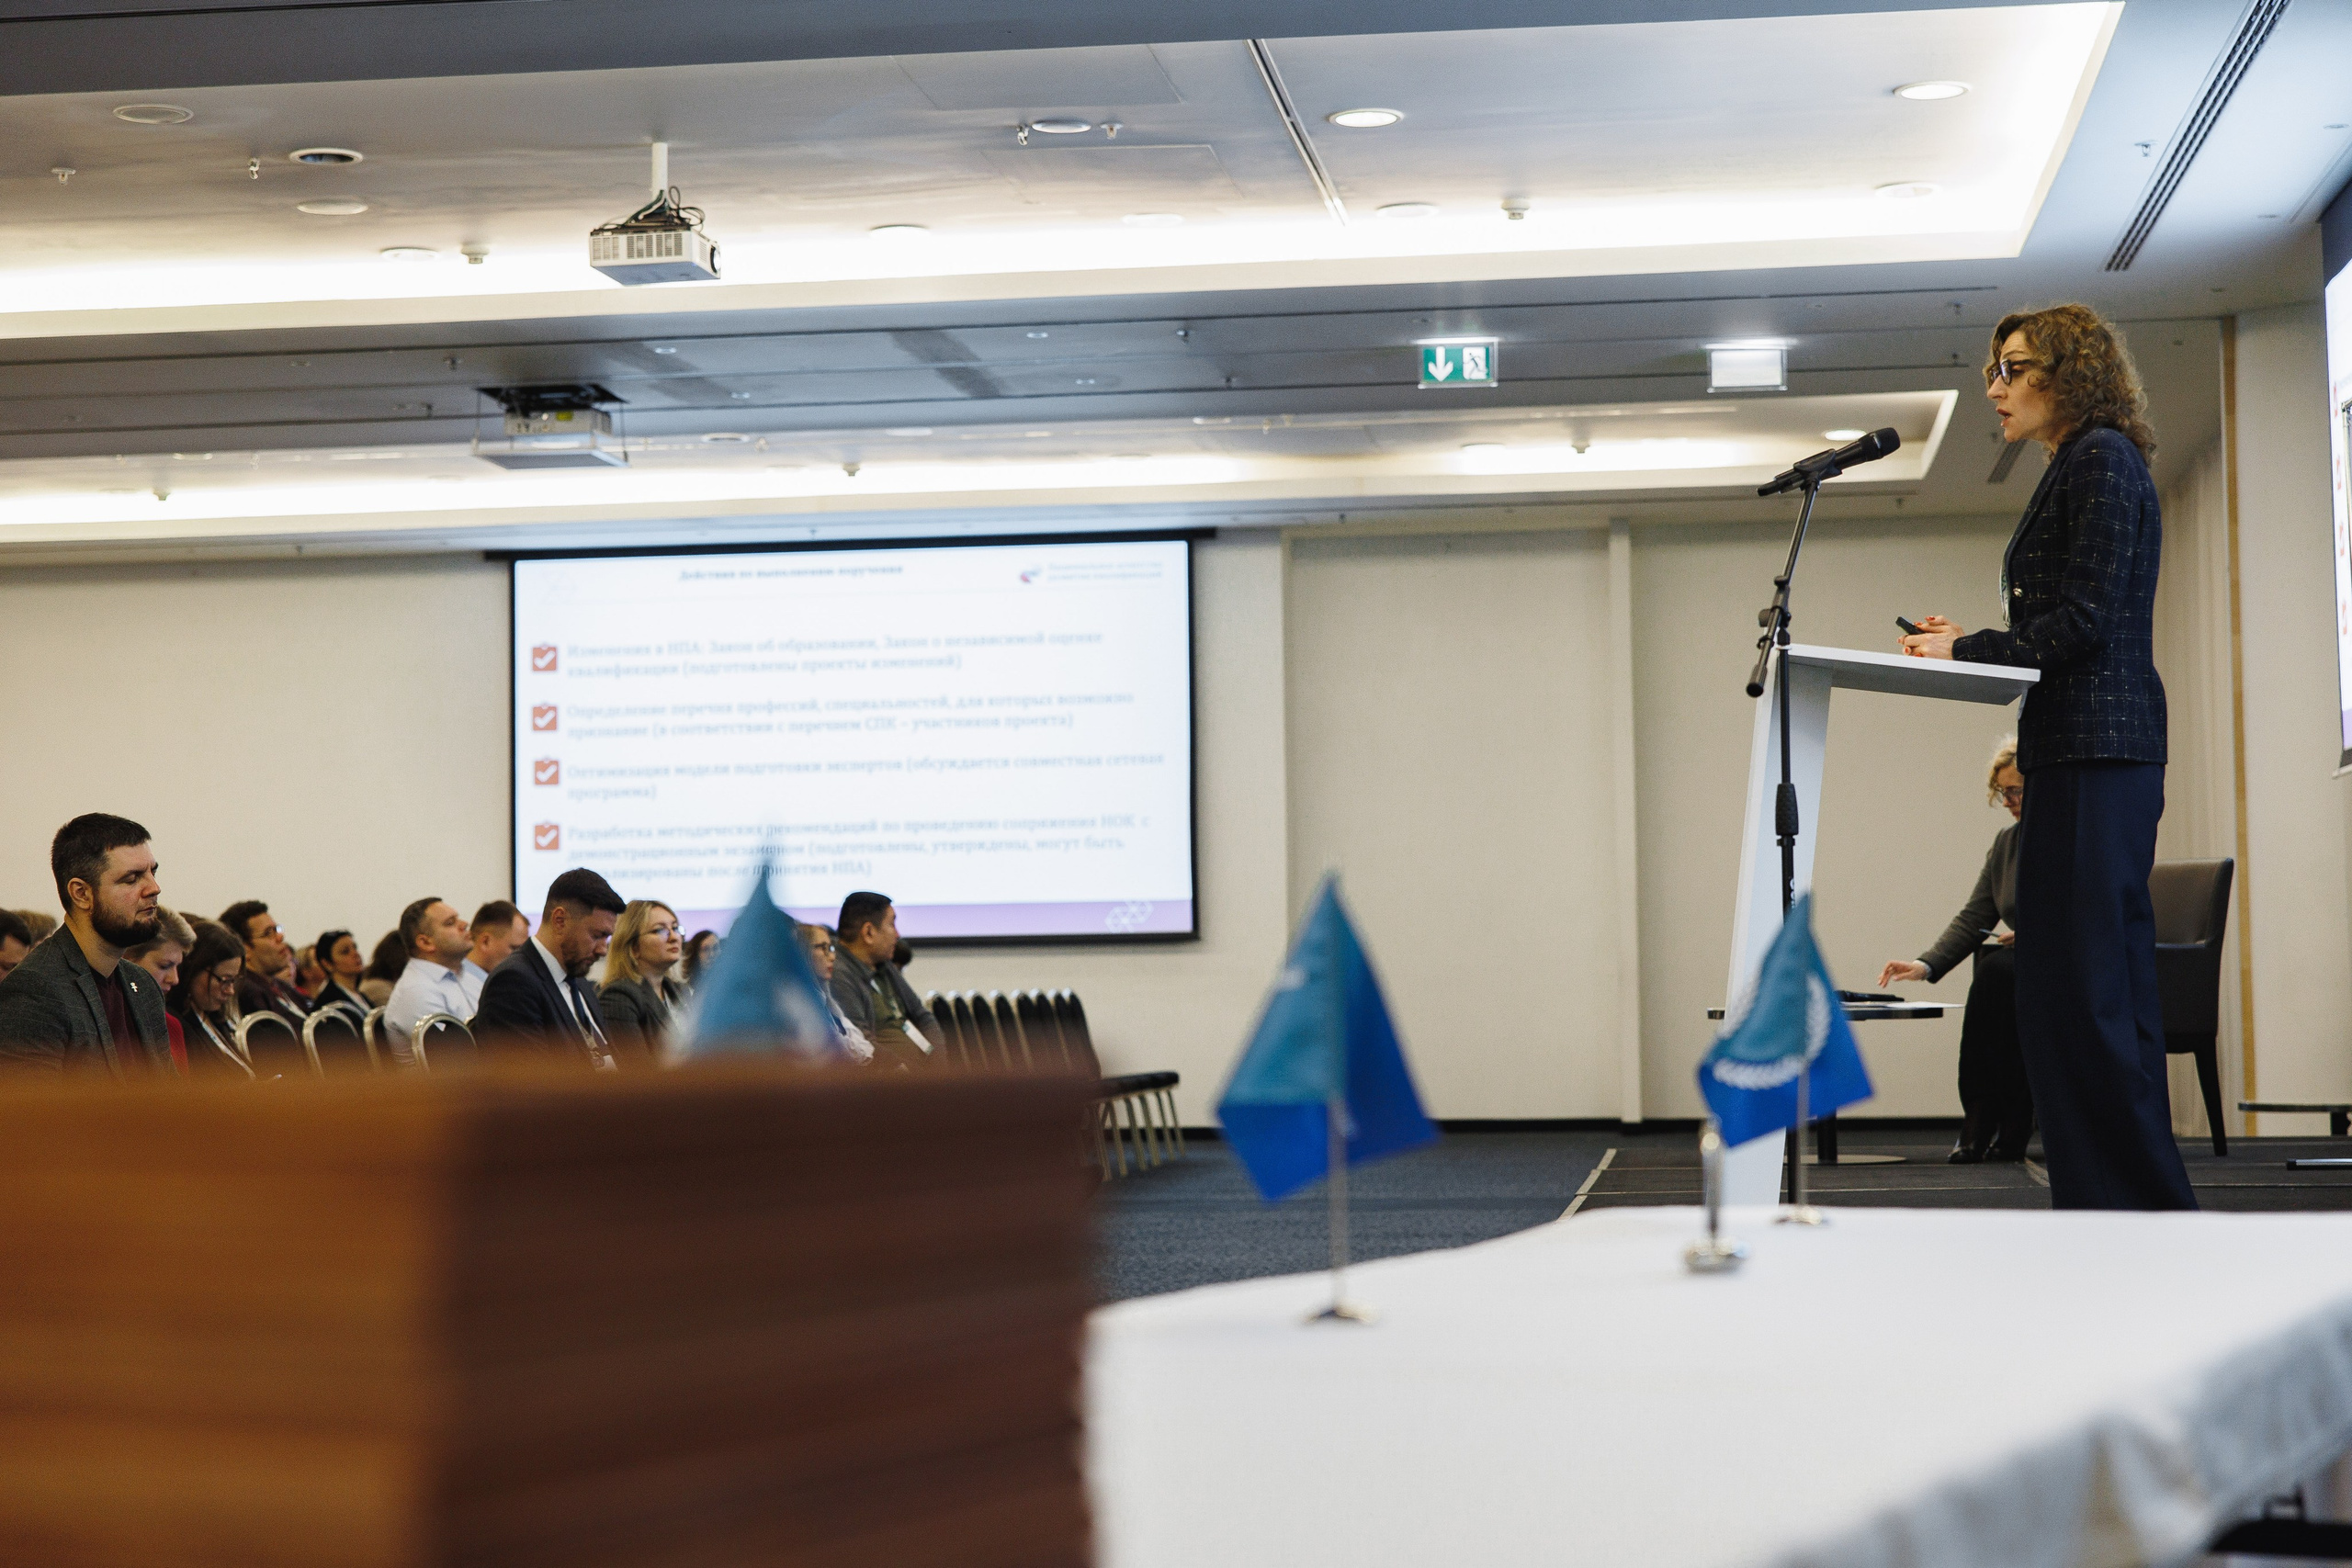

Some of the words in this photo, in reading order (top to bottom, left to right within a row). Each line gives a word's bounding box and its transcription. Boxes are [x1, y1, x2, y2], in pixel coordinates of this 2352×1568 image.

[709, 638, 753, 653] Закон
[757, 637, 775, 652] об
[884, 634, 928, 649] Закон
[933, 637, 942, 648] о
[1048, 632, 1102, 646] оценке
[801, 659, 866, 675] проекты
[567, 703, 667, 721] Определение
[737, 697, 820, 717] профессий,
[825, 694, 951, 713] специальностей,
[956, 697, 984, 710] для
[988, 695, 1053, 710] которых
[911, 716, 1001, 733] участников
[1004, 710, 1074, 730] проекта)
[906, 755, 1010, 774] (обсуждается
[1106, 753, 1165, 766] сетевая
[567, 783, 657, 803] программа)
[567, 824, 653, 843] Разработка
[882, 821, 900, 832] по
[1035, 838, 1080, 852] могут
[1084, 834, 1124, 849] быть
